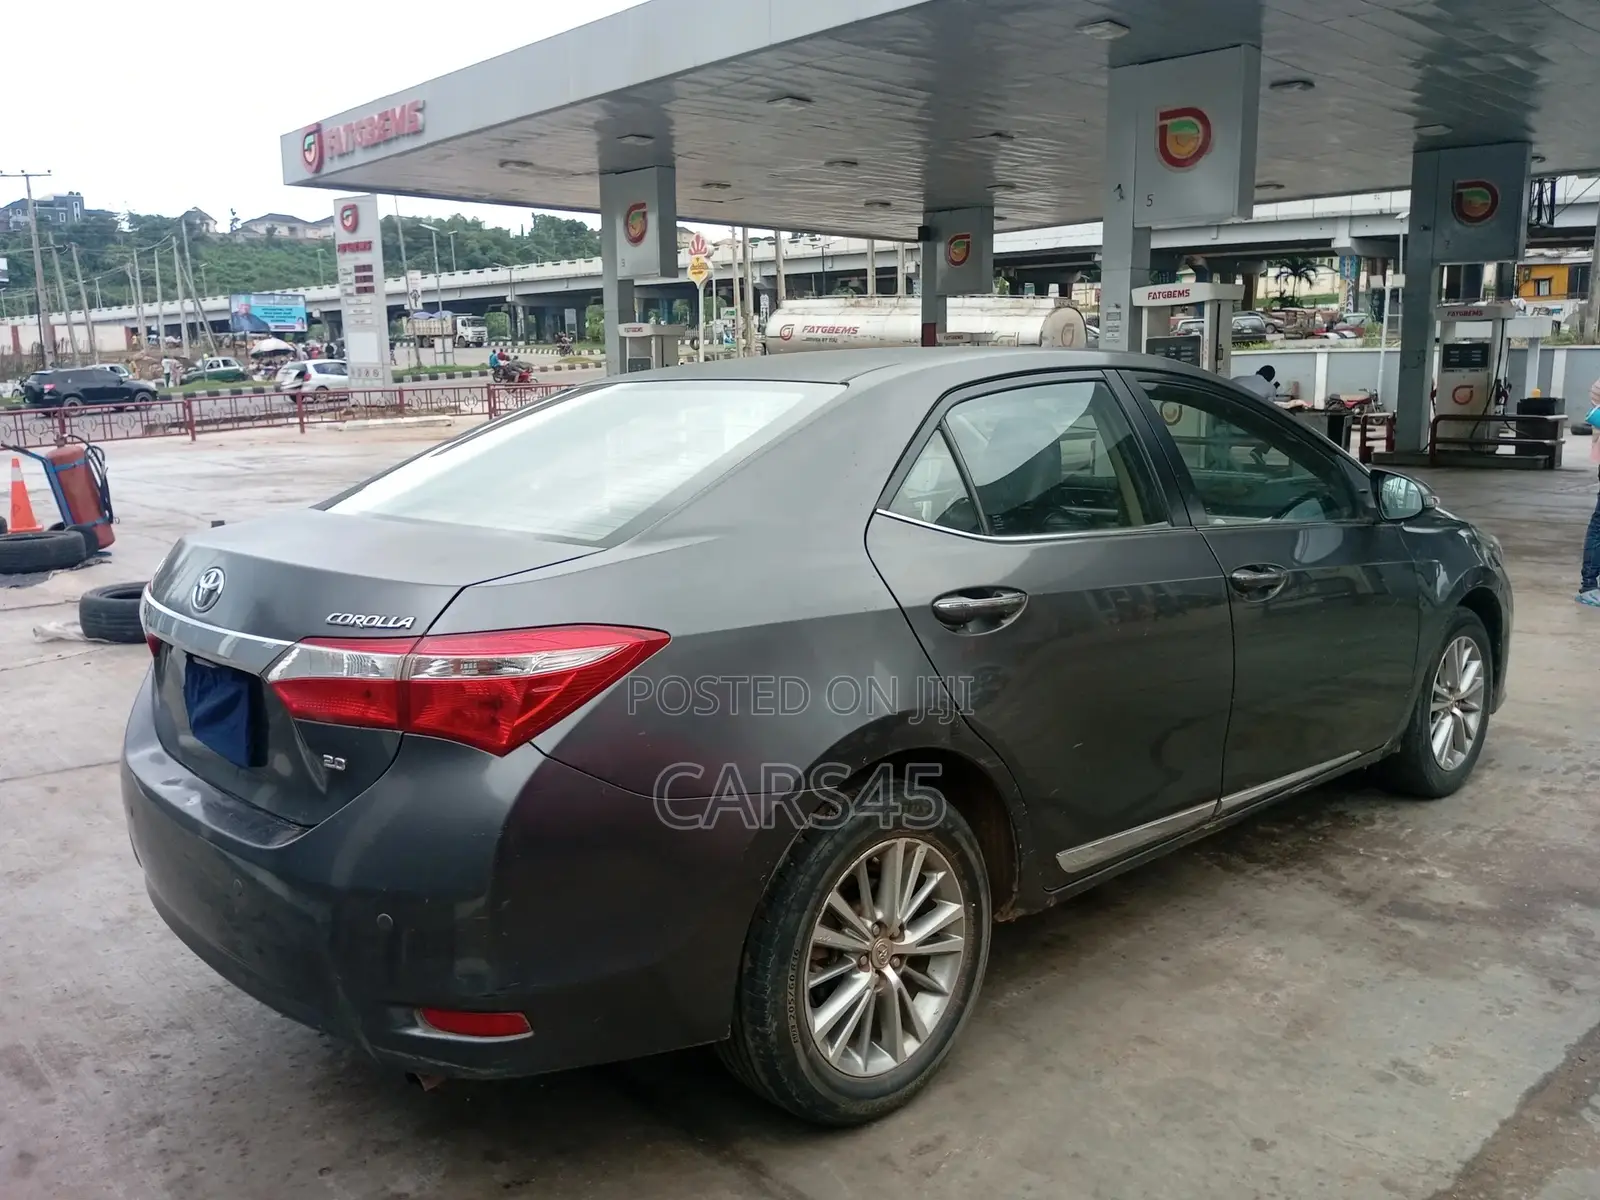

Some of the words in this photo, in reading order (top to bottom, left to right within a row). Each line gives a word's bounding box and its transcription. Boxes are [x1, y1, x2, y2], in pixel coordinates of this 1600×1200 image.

[1146, 193, 1154, 207] 5
[1147, 289, 1190, 300] FATGBEMS
[801, 325, 859, 335] FATGBEMS
[325, 612, 415, 629] COROLLA
